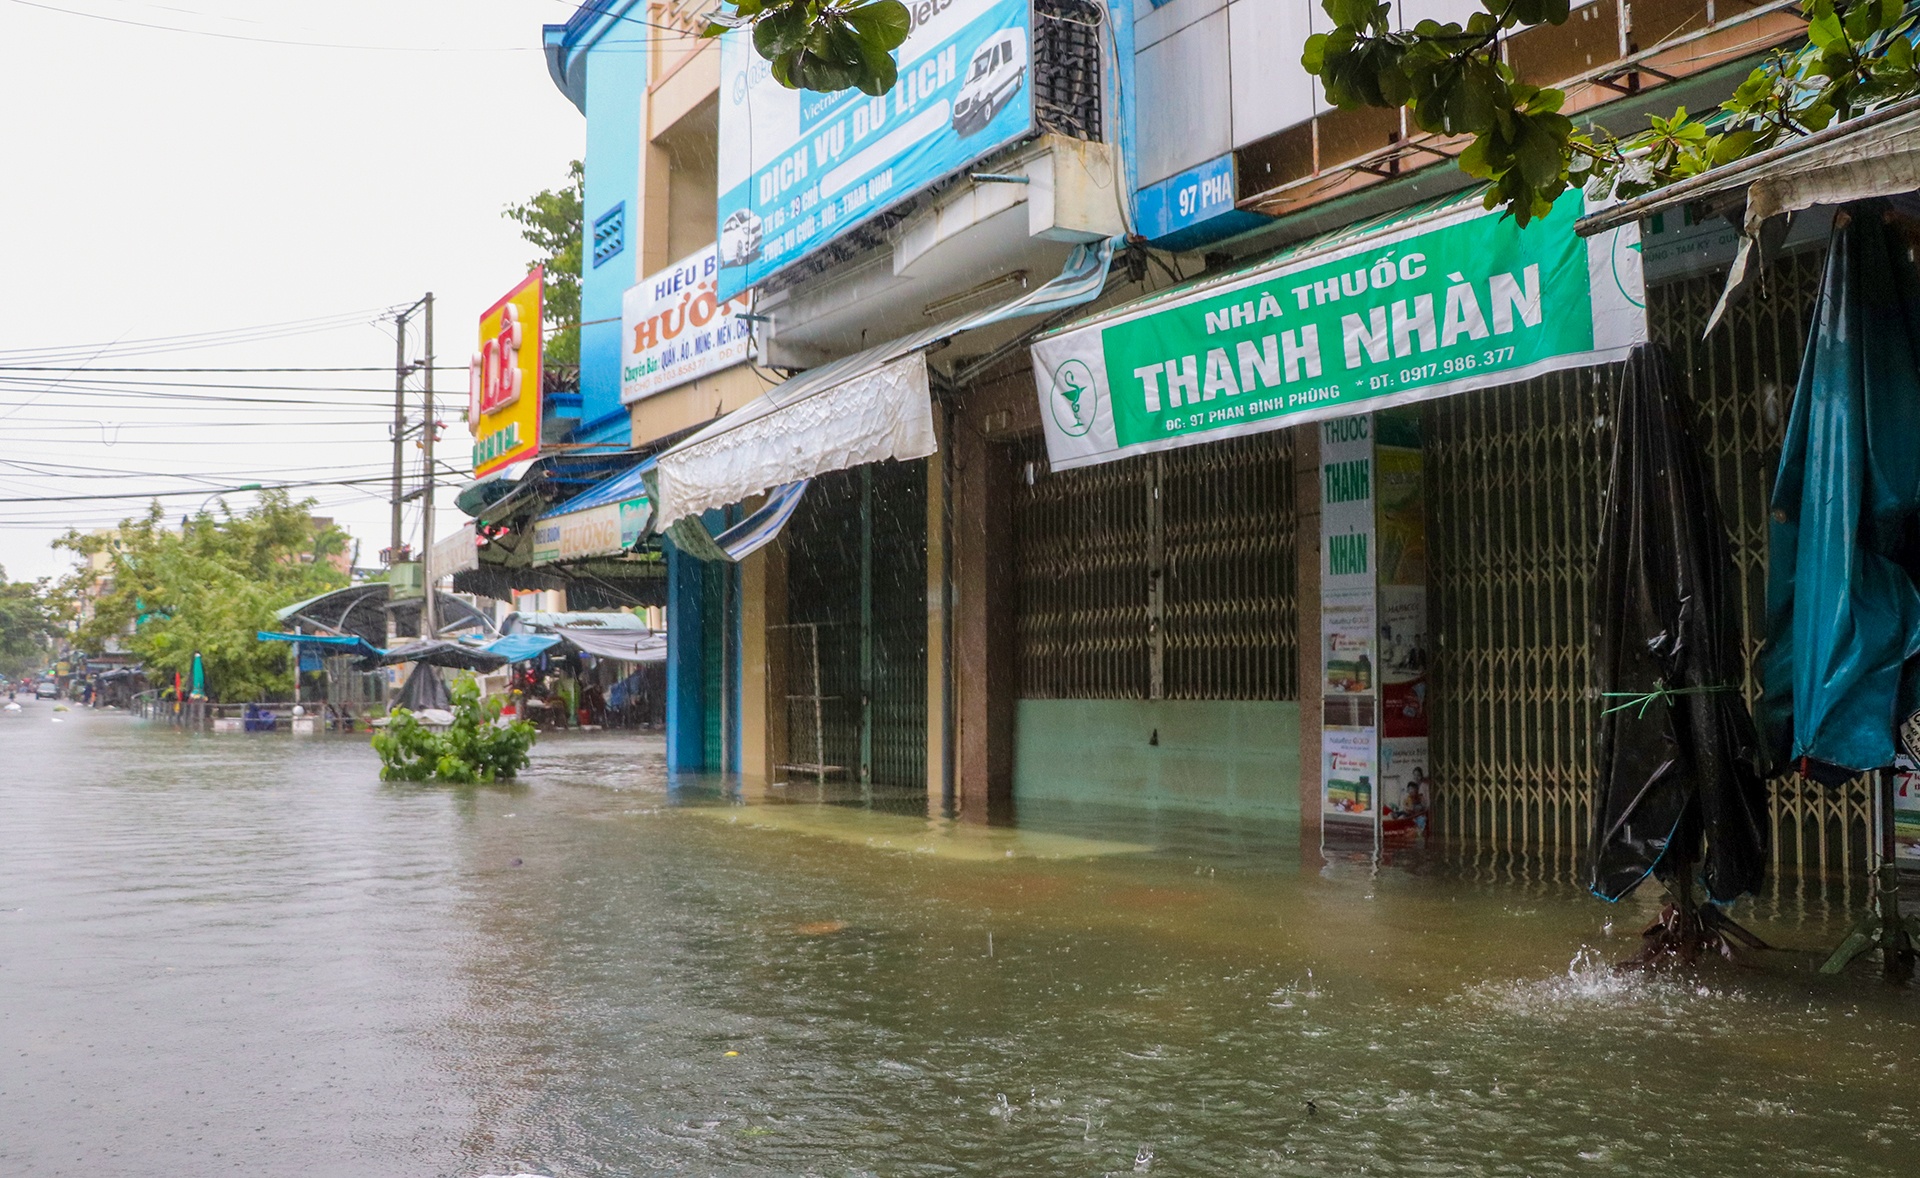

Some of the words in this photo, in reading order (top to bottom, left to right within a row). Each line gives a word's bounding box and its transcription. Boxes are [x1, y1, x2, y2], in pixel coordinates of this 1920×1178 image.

[760, 147, 808, 206] DỊCH
[814, 119, 845, 167] VỤ
[853, 94, 887, 143] DU
[895, 43, 956, 114] LỊCH
[790, 195, 801, 219] 29
[842, 182, 867, 215] THAM
[868, 167, 893, 201] QUAN
[1178, 184, 1198, 217] 97
[1202, 171, 1233, 209] PHA
[655, 264, 697, 302] HIỆU
[1204, 291, 1284, 335] NHÀ
[1291, 249, 1428, 310] THUỐC
[1133, 322, 1323, 414] THANH
[1340, 262, 1543, 370] NHÀN
[1165, 418, 1186, 432] ĐC:
[1190, 412, 1204, 427] 97
[1208, 404, 1245, 424] PHAN
[1248, 396, 1285, 416] ĐÌNH
[1288, 384, 1341, 408] PHÙNG
[1370, 374, 1395, 391] ĐT:
[1399, 346, 1516, 385] 0917.986.377
[1324, 458, 1370, 503] THANH
[1329, 525, 1368, 576] NHÀN
[1331, 633, 1339, 651] 7
[1331, 751, 1339, 770] 7
[1897, 772, 1914, 797] 7
